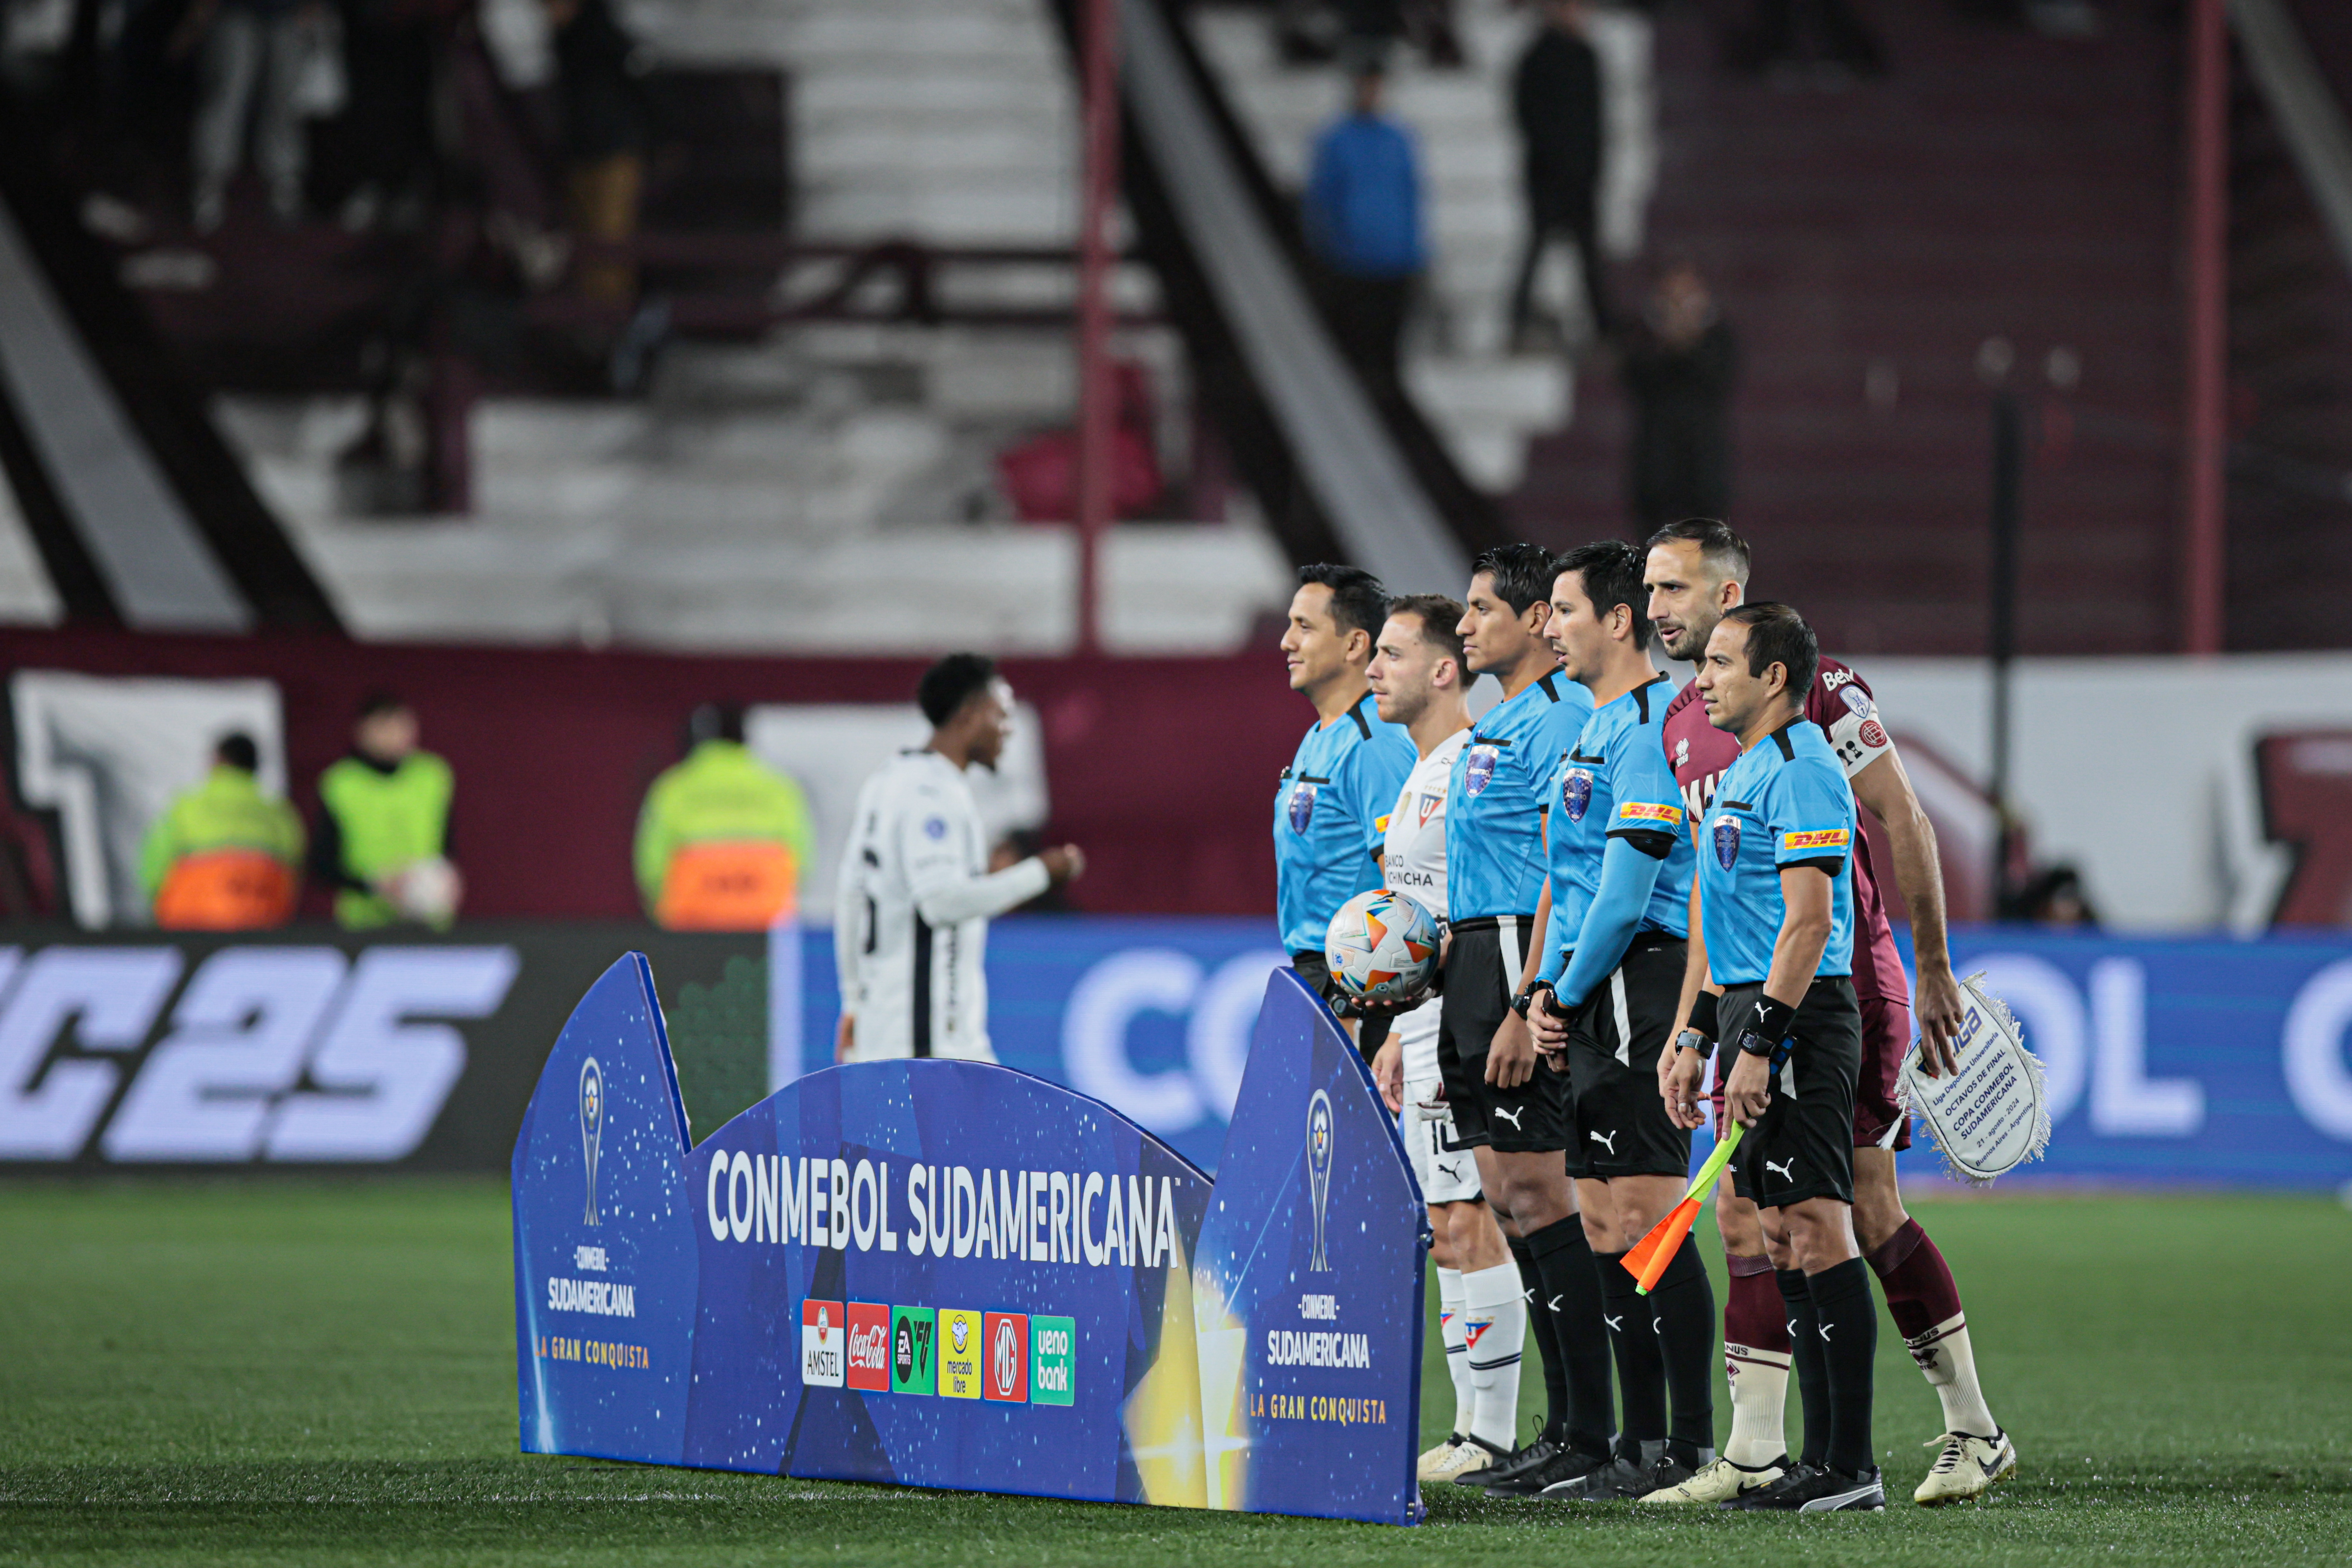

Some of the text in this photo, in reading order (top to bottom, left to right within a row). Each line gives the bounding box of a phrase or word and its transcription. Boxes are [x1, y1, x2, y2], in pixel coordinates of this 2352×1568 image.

[1629, 805, 1675, 820] DHL
[1793, 832, 1843, 846] DHL
[1385, 855, 1403, 867] BANCO
[1387, 872, 1433, 886] ICHINCHA
[0, 945, 520, 1162] C25
[1933, 1032, 1999, 1106] Liga Deportiva Universitaria
[1945, 1049, 2006, 1116] OCTAVOS DE FINAL
[1953, 1063, 2014, 1131] COPA CONMEBOL
[1961, 1076, 2017, 1140] SUDAMERICANA
[1977, 1138, 1985, 1148] 21
[1988, 1117, 2004, 1137] agosto
[2006, 1098, 2019, 1115] 2024
[1976, 1145, 1995, 1166] Buenos
[1995, 1132, 2008, 1147] Aires
[2010, 1102, 2033, 1130] Argentina
[708, 1149, 897, 1252] CONMEBOL
[907, 1163, 1177, 1268] SUDAMERICANA
[548, 1277, 635, 1318] SUDAMERICANA
[535, 1336, 649, 1370] LA GRAN CONQUISTA
[848, 1323, 887, 1369] Coca-Cola
[898, 1330, 911, 1353] EA
[996, 1326, 1015, 1389] MG
[1038, 1330, 1068, 1356] ueno
[1268, 1330, 1370, 1369] SUDAMERICANA
[807, 1350, 839, 1377] AMSTEL
[897, 1354, 911, 1365] SPORTS
[947, 1358, 972, 1375] mercado
[1038, 1356, 1068, 1391] bank
[953, 1376, 966, 1393] libre
[1250, 1393, 1386, 1427] LA GRAN CONQUISTA
